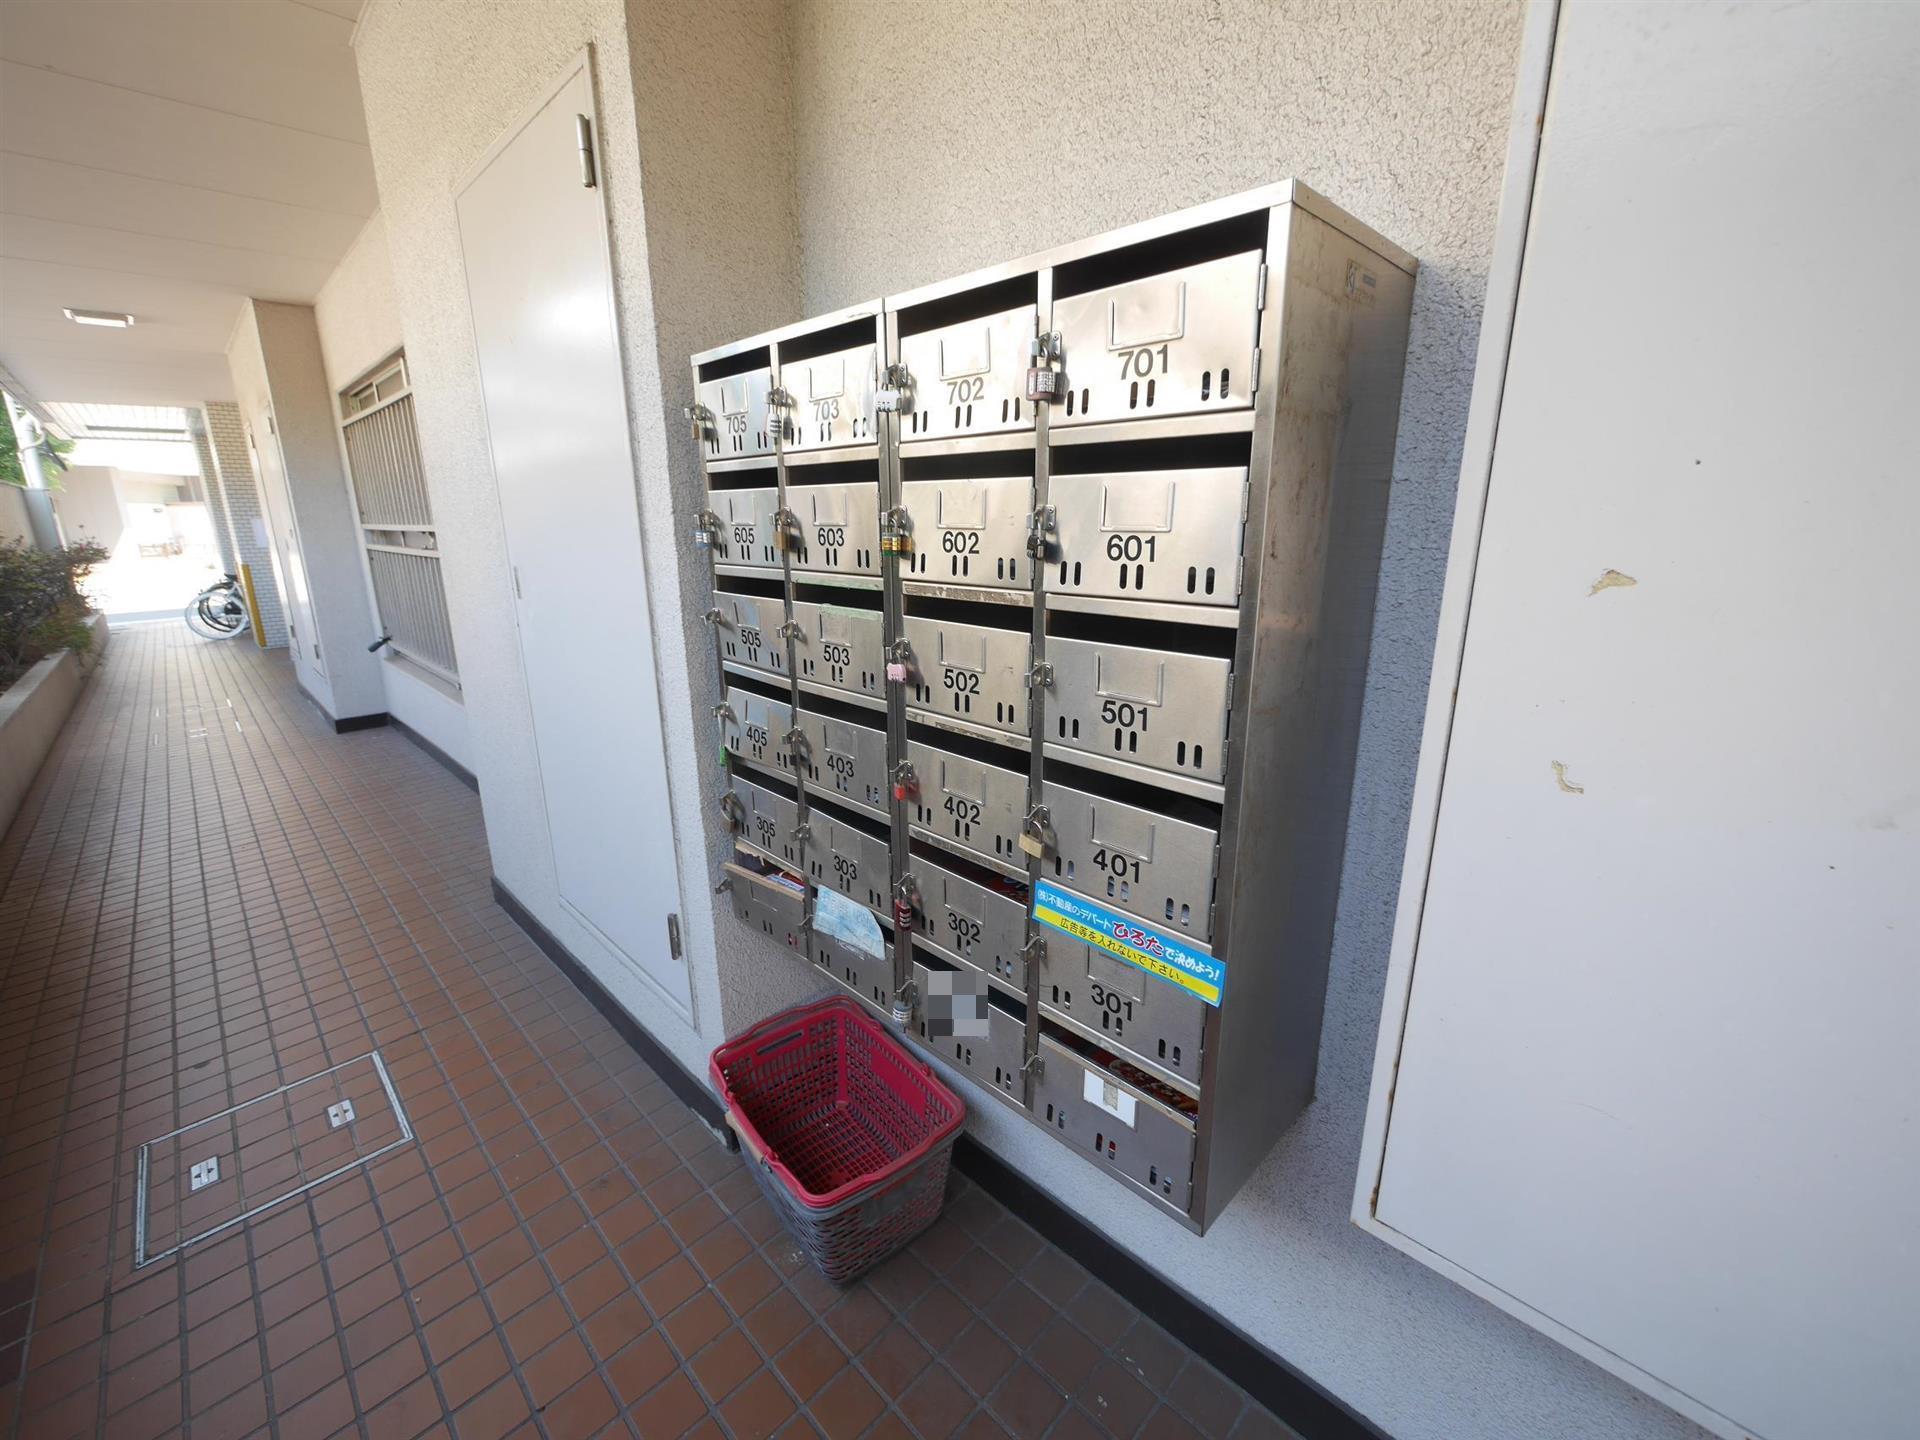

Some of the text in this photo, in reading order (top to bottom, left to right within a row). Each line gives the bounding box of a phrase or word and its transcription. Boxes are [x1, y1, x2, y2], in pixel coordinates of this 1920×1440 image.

[1118, 344, 1169, 381] 701
[947, 377, 985, 406] 702
[813, 400, 840, 421] 703
[726, 415, 747, 434] 705
[734, 527, 755, 545] 605
[817, 527, 845, 547] 603
[942, 531, 981, 554] 602
[1106, 534, 1156, 563] 601
[740, 629, 762, 649] 505
[823, 644, 850, 666] 503
[943, 669, 980, 695] 502
[1100, 700, 1148, 731] 501
[746, 725, 768, 747] 405
[826, 754, 855, 778] 403
[944, 795, 981, 826] 402
[756, 815, 776, 837] 305
[833, 854, 857, 880] 303
[1092, 848, 1140, 884] 401
[947, 912, 982, 944] 302
[1090, 983, 1134, 1021] 301
